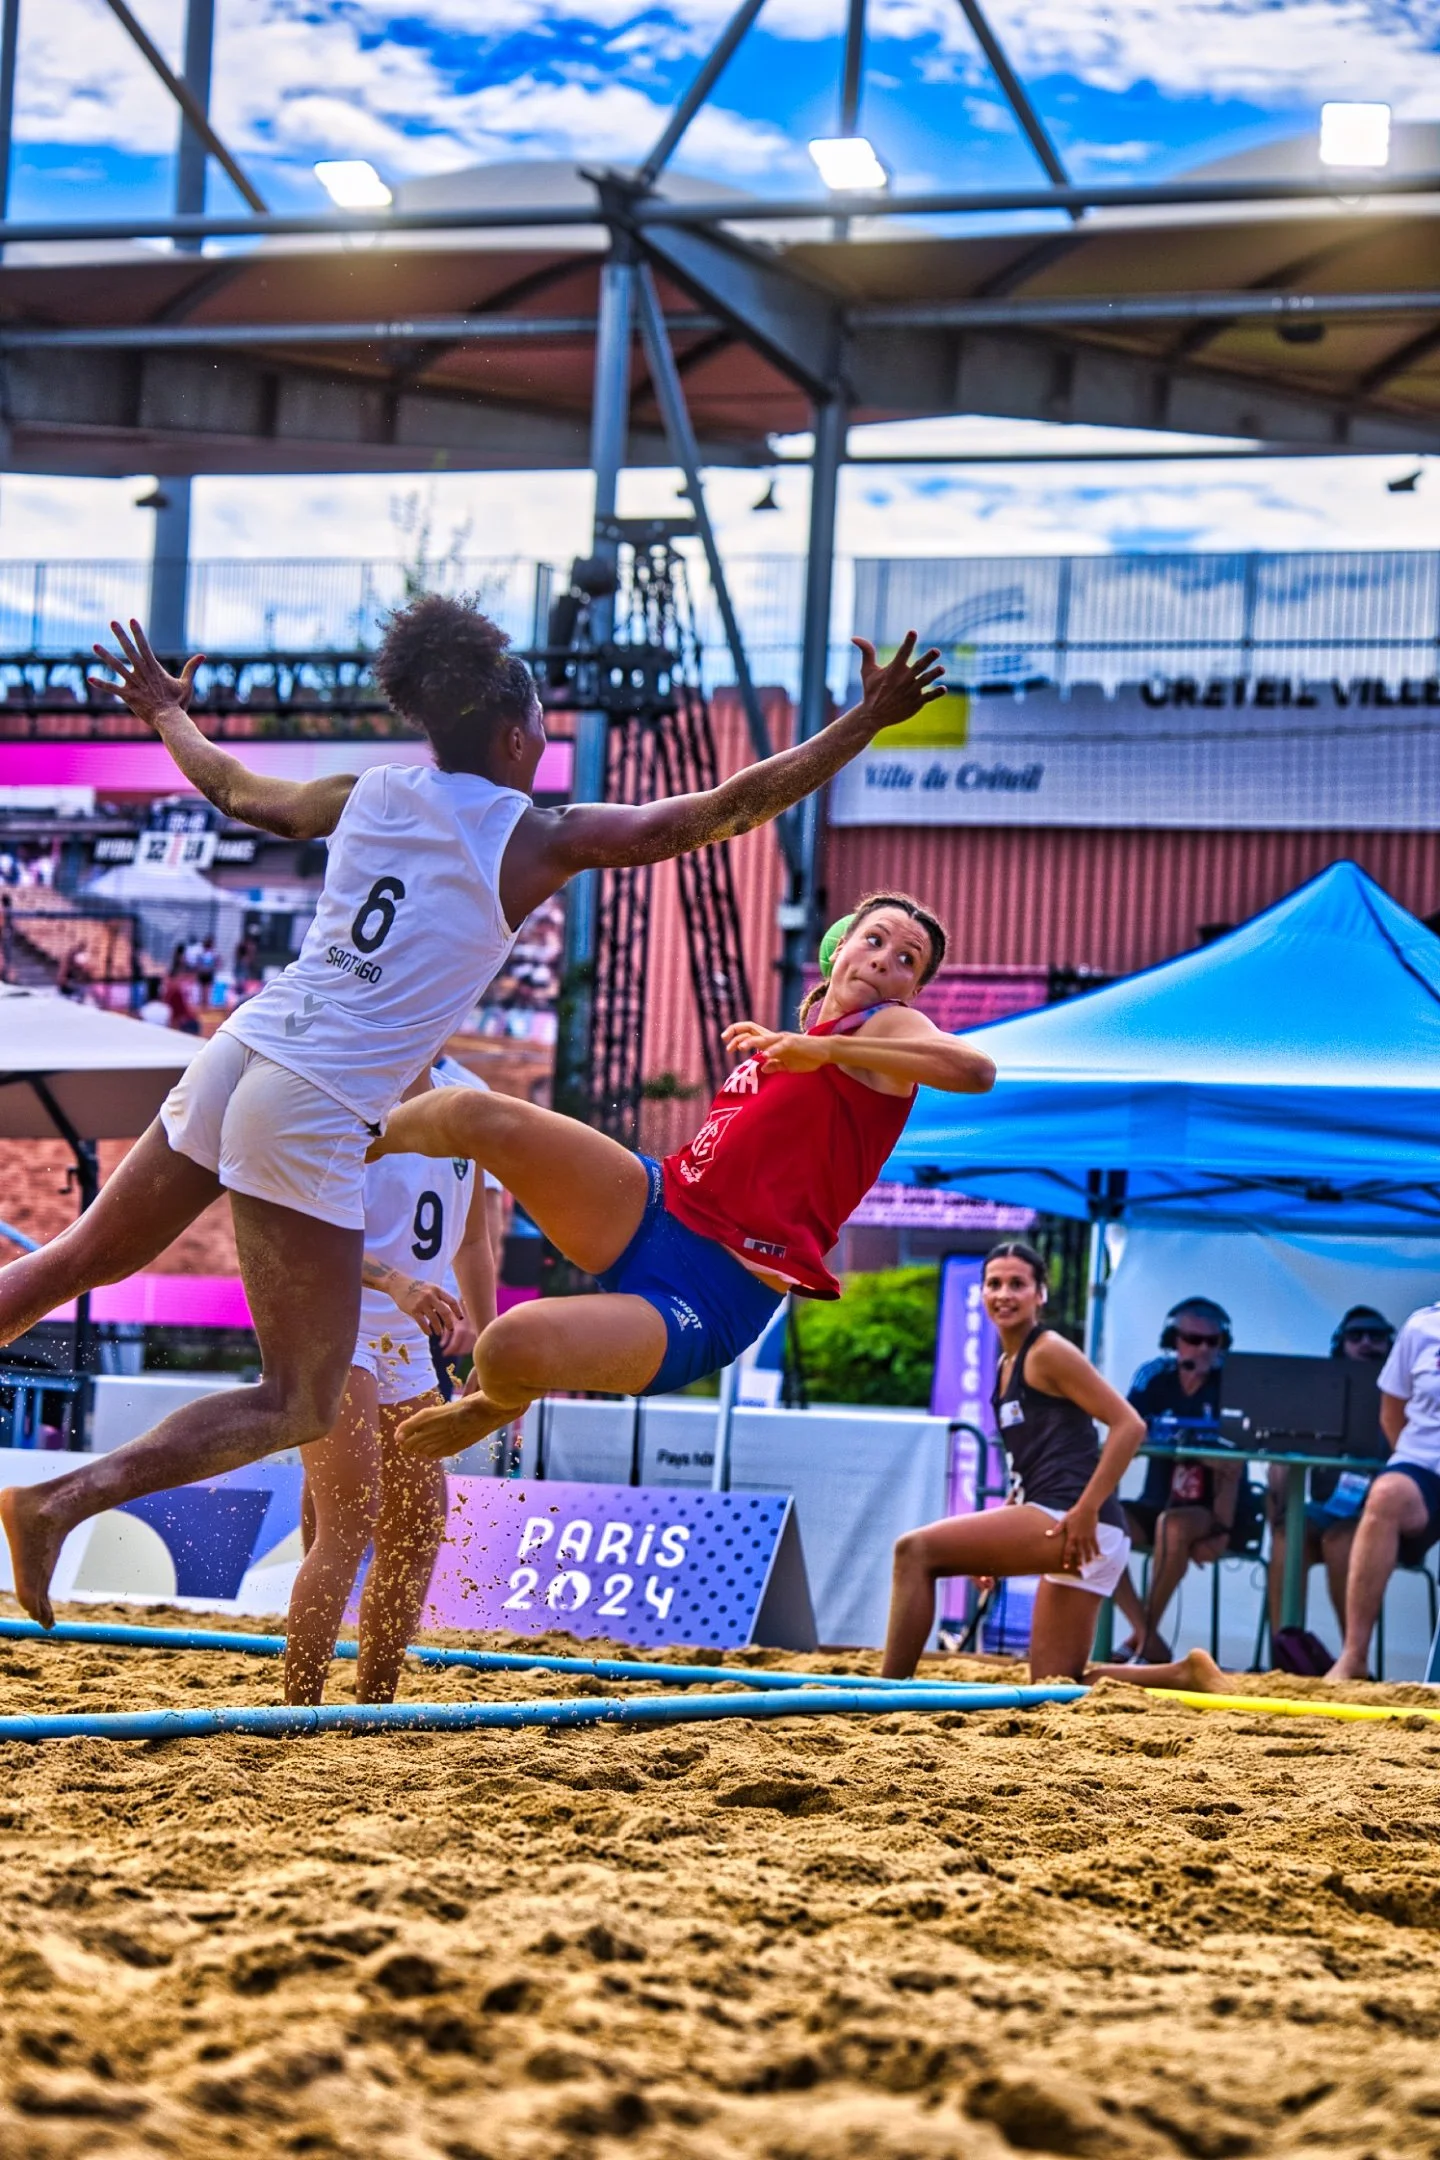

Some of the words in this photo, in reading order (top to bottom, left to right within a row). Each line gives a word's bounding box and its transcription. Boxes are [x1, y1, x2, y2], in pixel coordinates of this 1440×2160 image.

[351, 875, 406, 954] 6
[411, 1190, 444, 1261] 9
[501, 1566, 675, 1620] 2024
